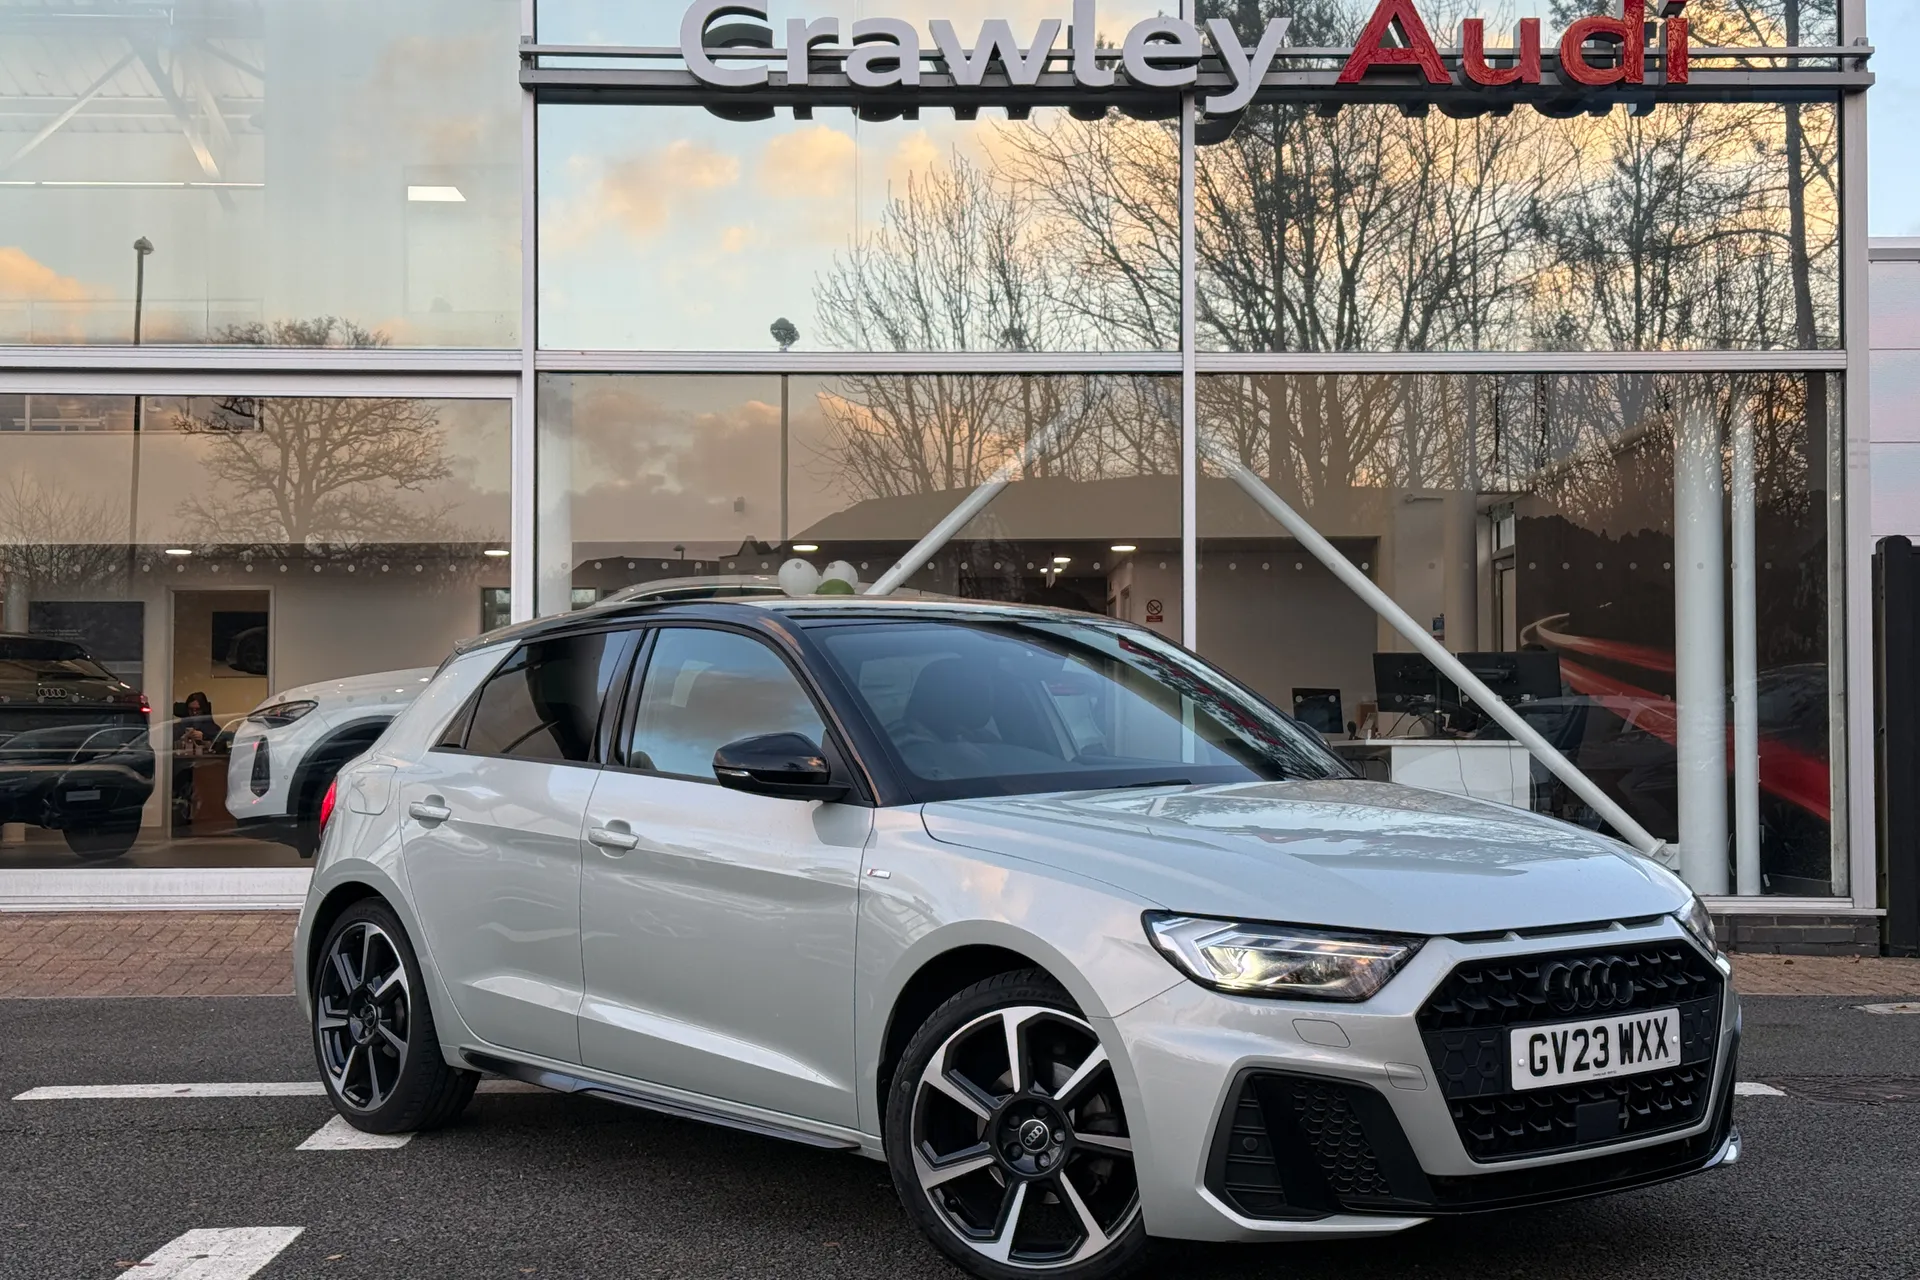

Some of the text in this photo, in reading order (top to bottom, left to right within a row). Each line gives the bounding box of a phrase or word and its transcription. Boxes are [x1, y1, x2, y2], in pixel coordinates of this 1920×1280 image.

[680, 0, 1689, 113] Crawley Audi
[1529, 1016, 1669, 1077] GV23 WXX
